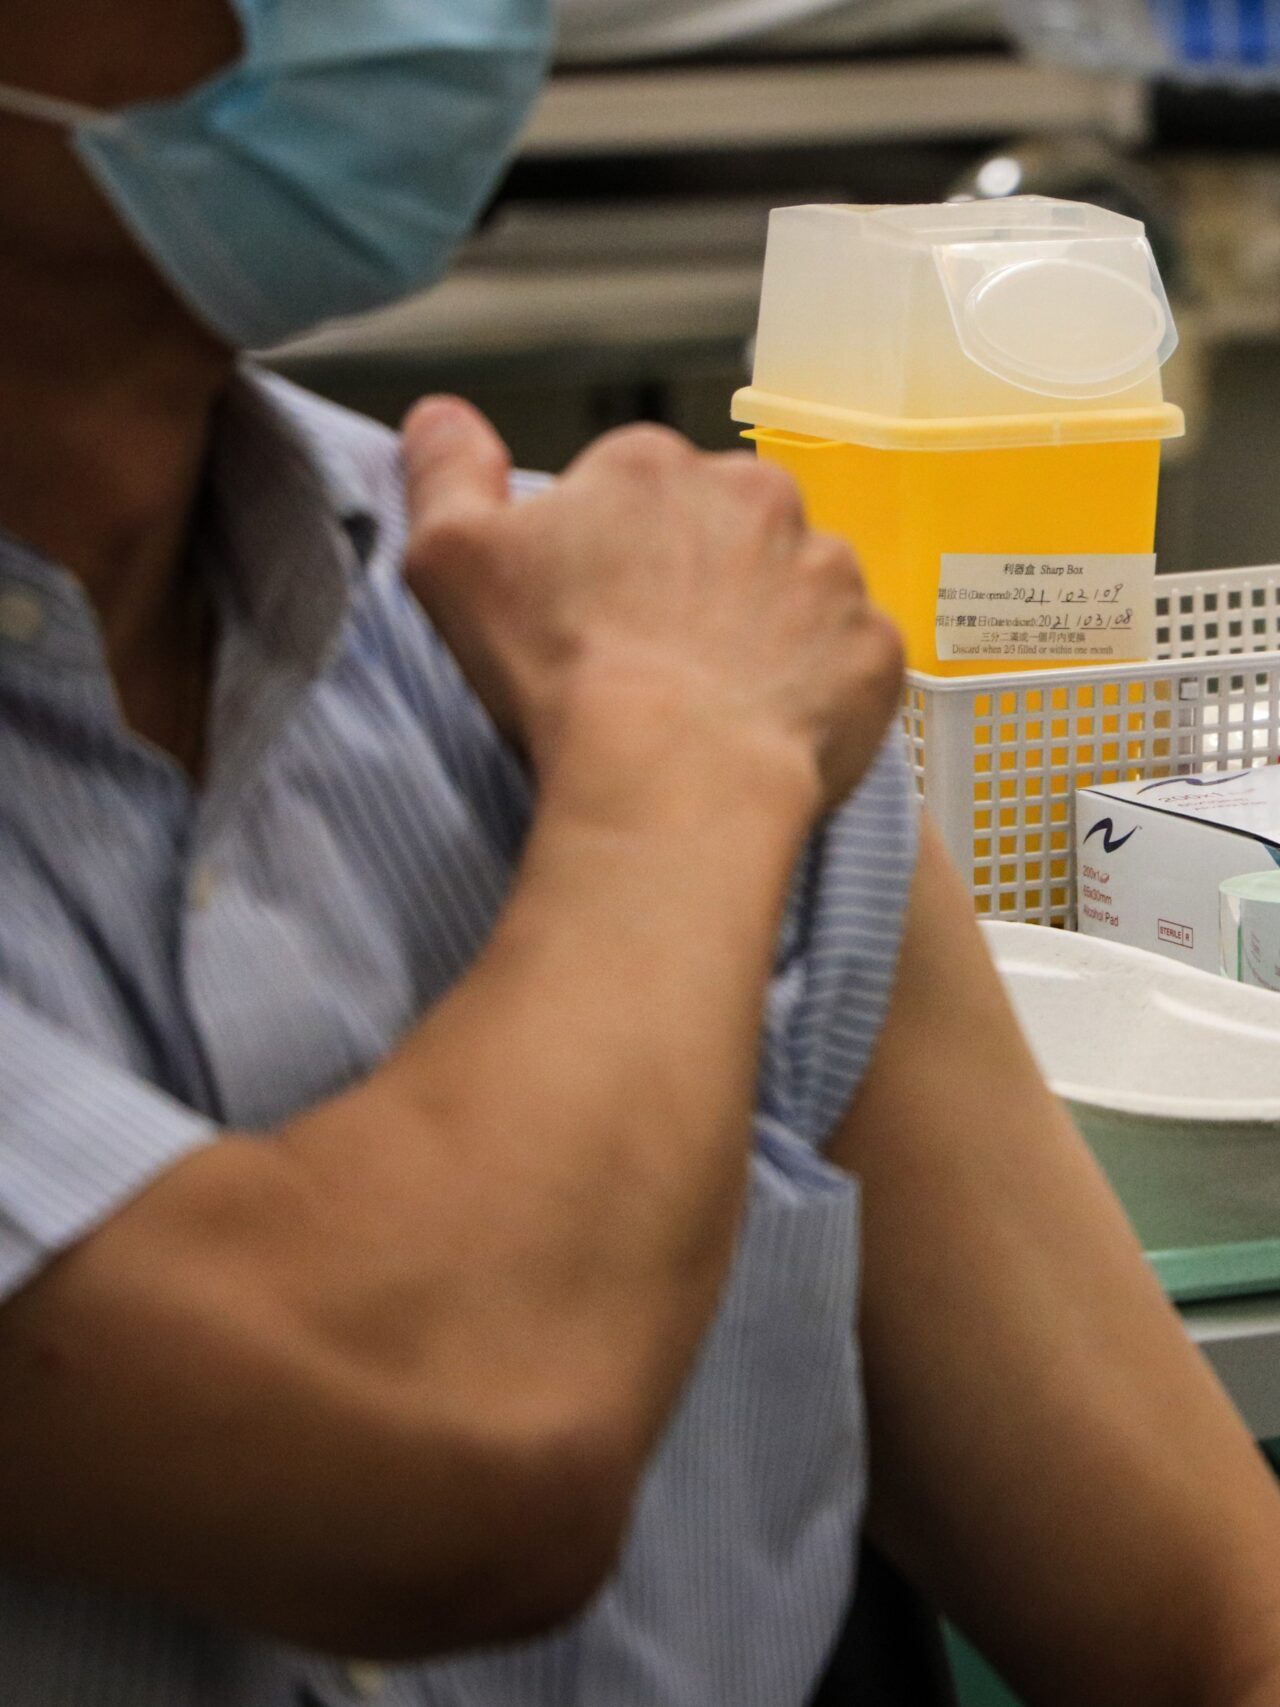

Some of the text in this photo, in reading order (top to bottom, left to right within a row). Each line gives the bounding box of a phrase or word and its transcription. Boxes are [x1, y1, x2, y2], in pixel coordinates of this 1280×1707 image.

[1040, 564, 1064, 576] Sharp
[1066, 564, 1084, 575] Box
[1105, 911, 1119, 927] Pad
[1160, 926, 1182, 939] STERILE
